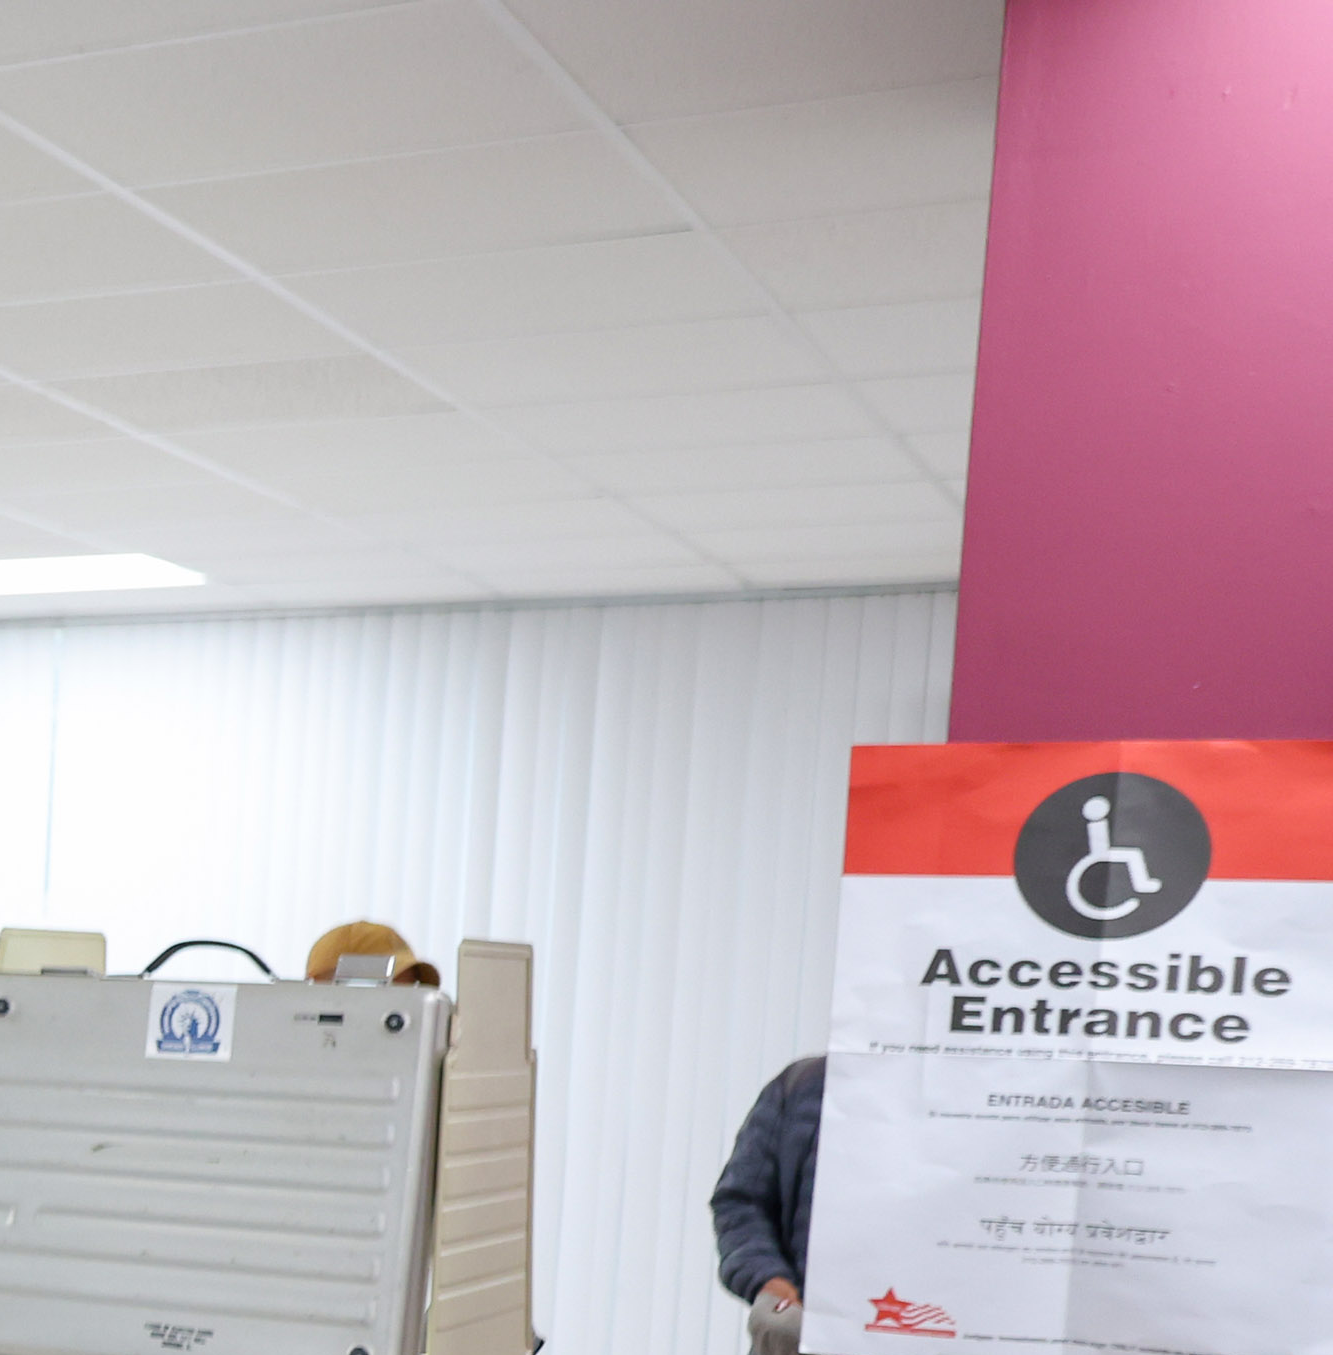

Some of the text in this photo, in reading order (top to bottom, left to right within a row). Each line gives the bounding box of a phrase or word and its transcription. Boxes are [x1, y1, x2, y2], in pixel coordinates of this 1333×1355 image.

[920, 948, 1293, 997] Accessible
[949, 996, 1251, 1044] Entrance
[883, 1043, 905, 1055] you
[909, 1043, 940, 1054] need
[987, 1093, 1191, 1115] ENTRADA ACCESIBLE
